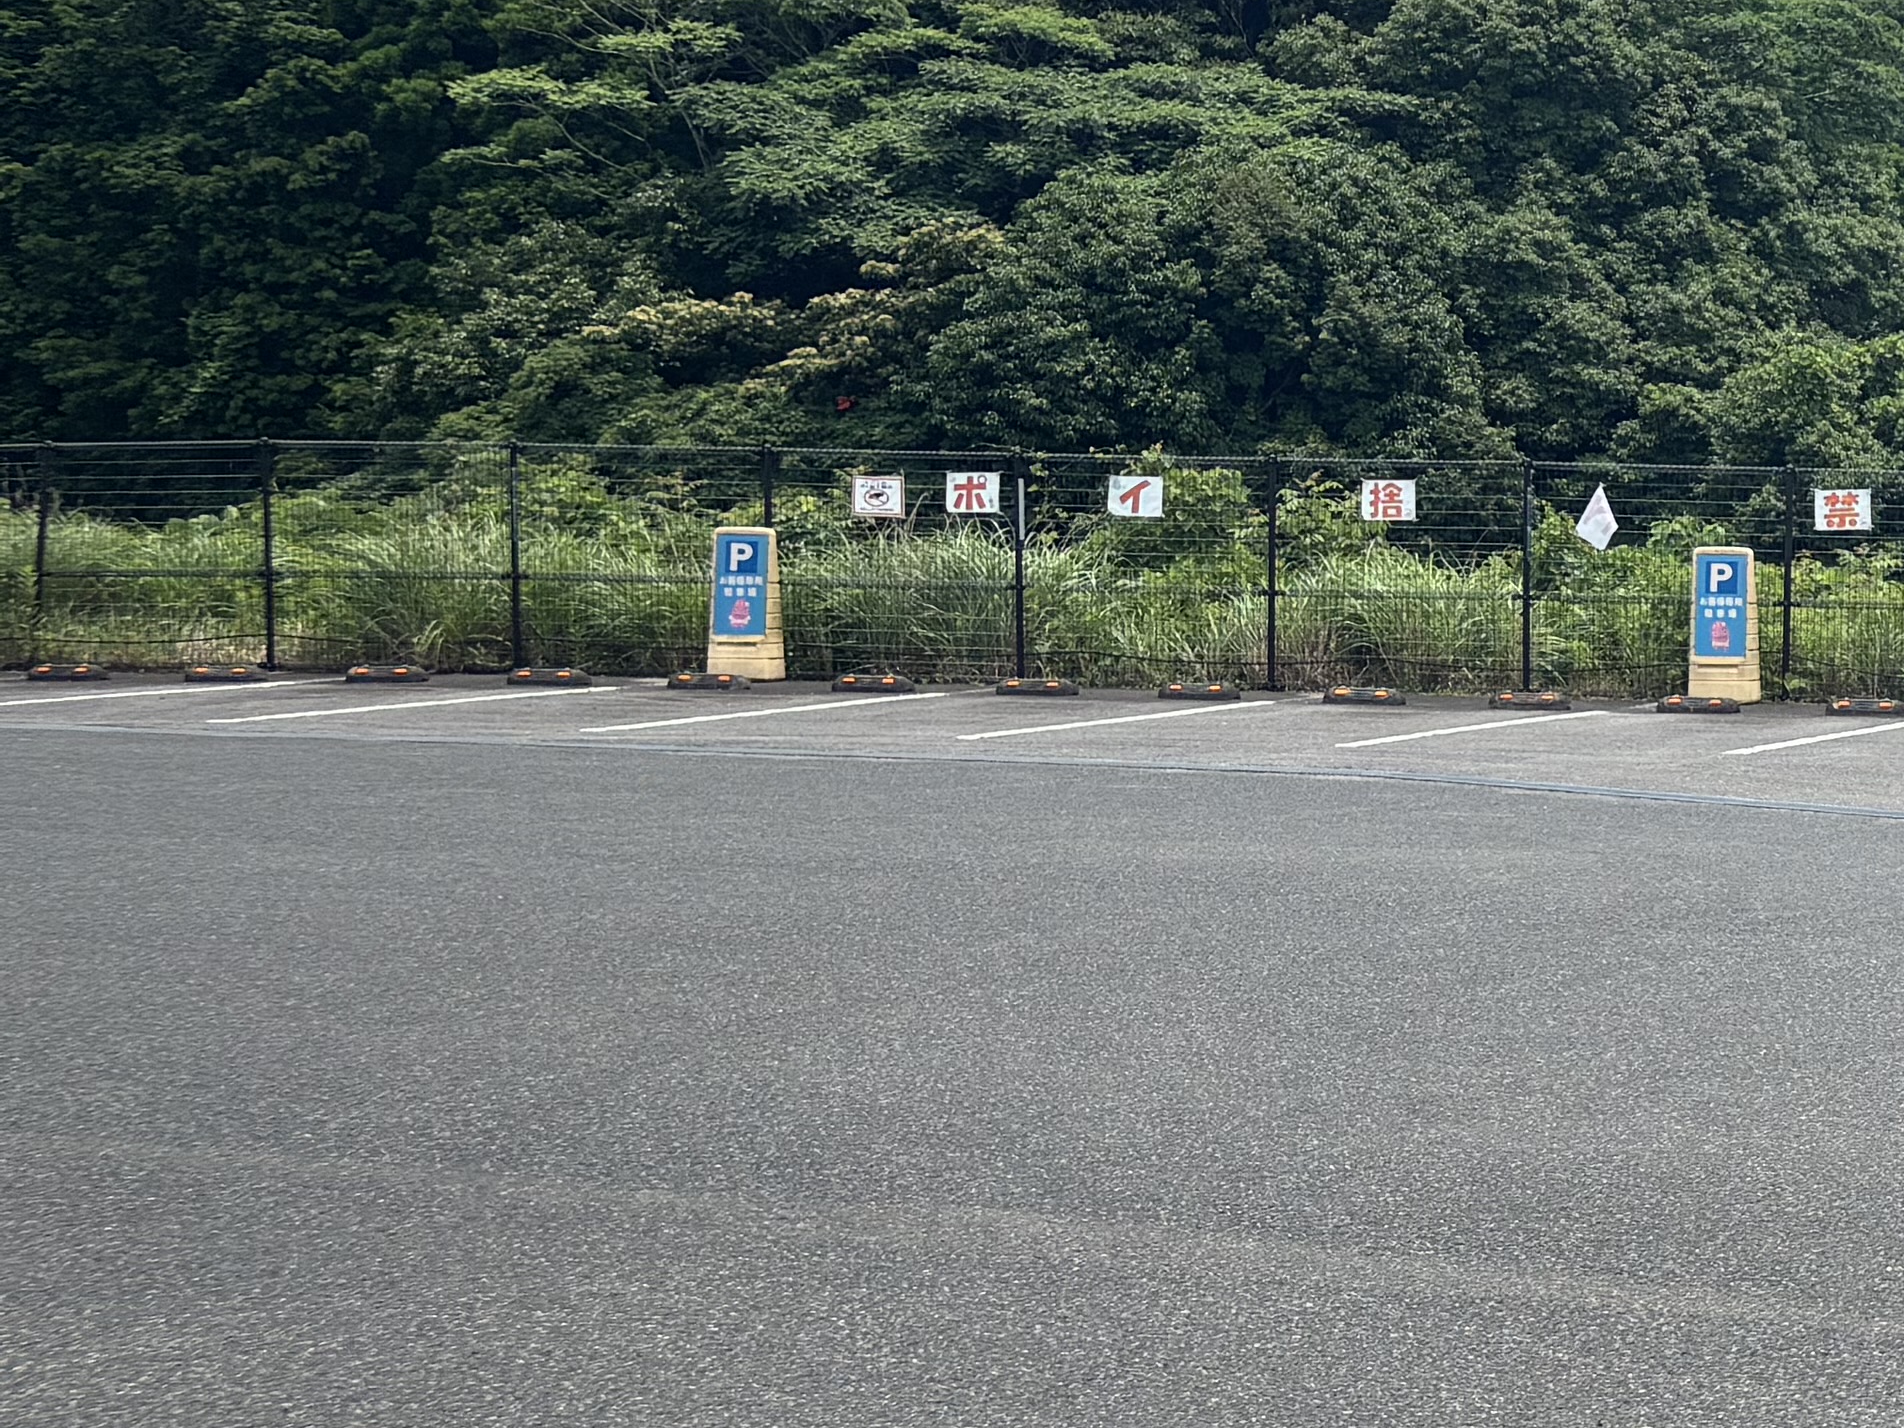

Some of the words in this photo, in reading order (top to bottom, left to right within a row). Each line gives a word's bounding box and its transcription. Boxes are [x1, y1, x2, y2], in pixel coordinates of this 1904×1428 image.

[954, 475, 988, 510] ポ
[1119, 480, 1151, 513] イ
[1369, 482, 1403, 518] 捨
[1824, 492, 1859, 527] 禁
[730, 543, 753, 571] P
[1710, 563, 1733, 592] P
